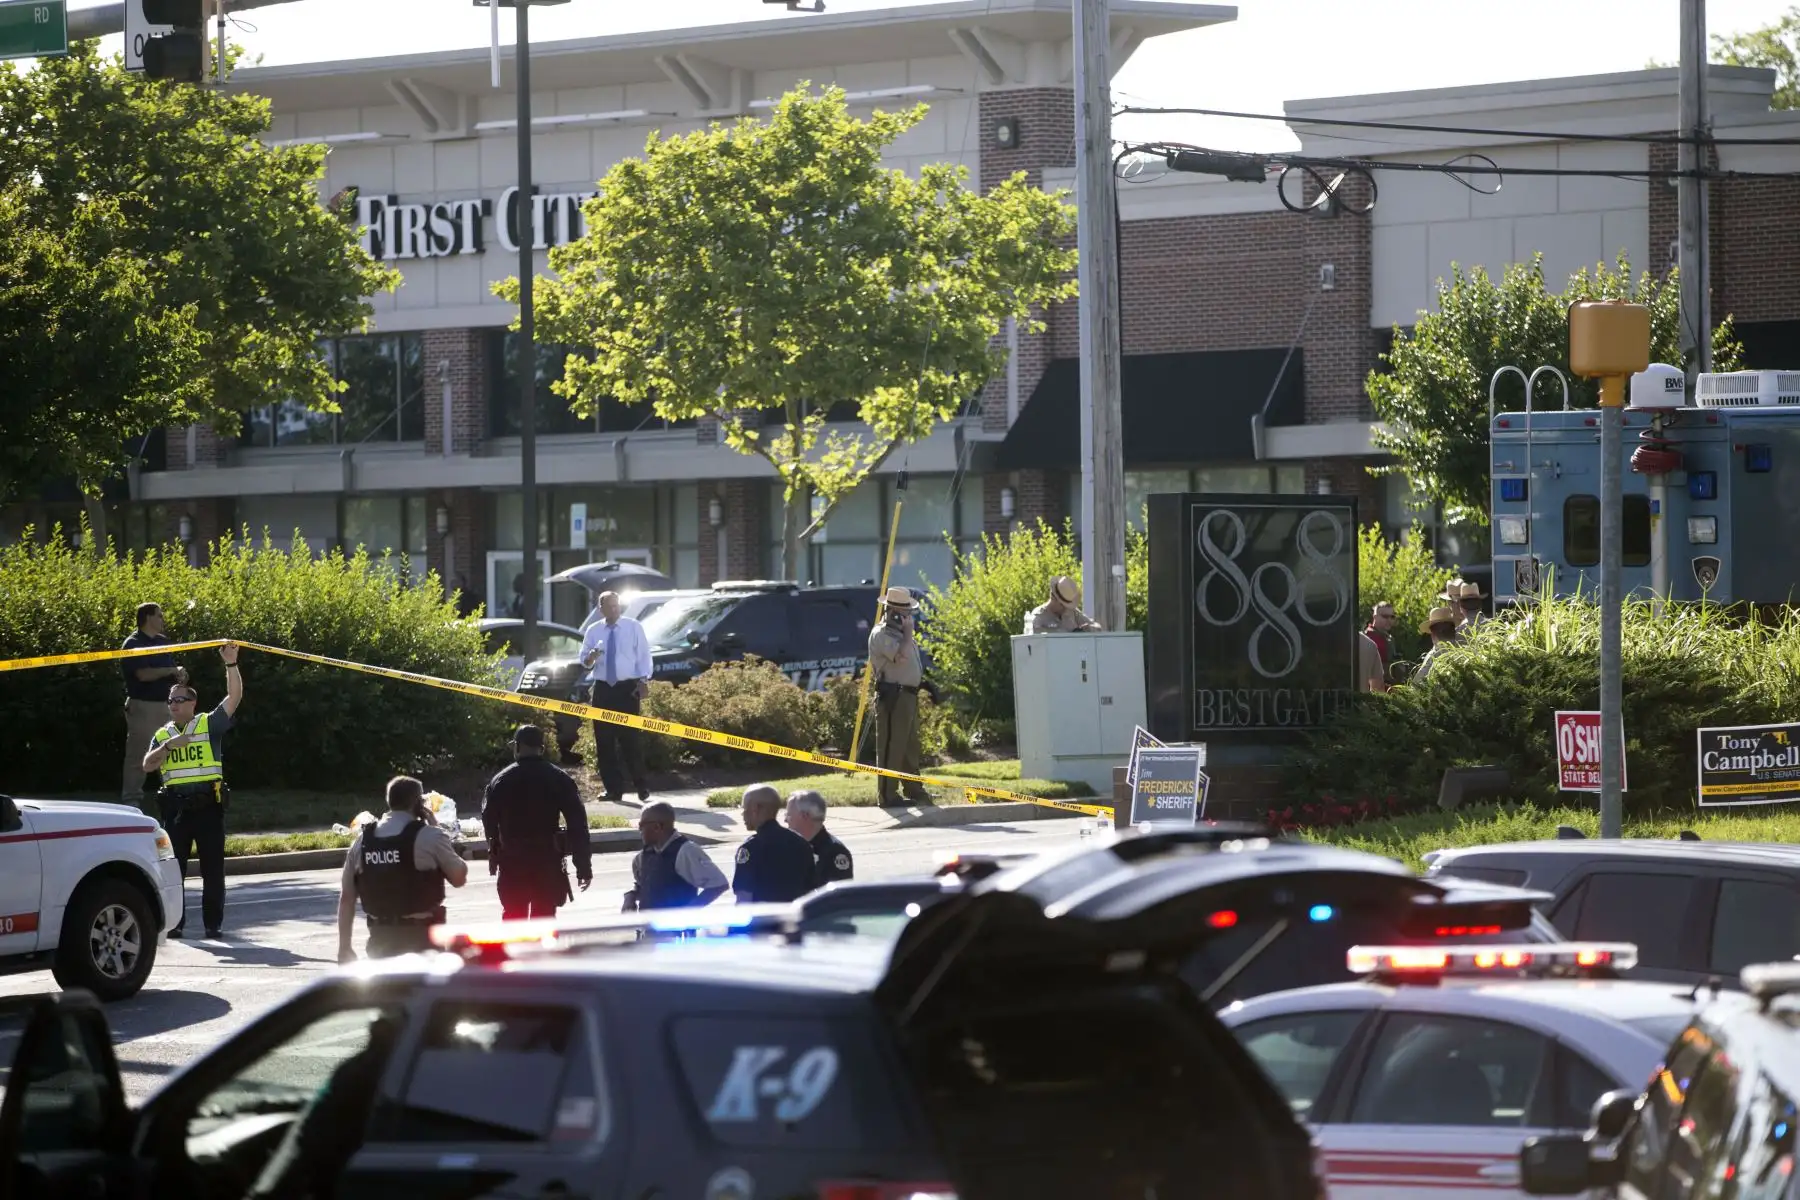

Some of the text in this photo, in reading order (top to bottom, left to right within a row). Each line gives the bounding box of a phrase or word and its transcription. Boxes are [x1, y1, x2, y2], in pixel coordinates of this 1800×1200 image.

[34, 7, 49, 24] RD
[357, 194, 484, 260] FIRST
[1664, 377, 1684, 389] BMS
[1197, 509, 1349, 679] 888
[820, 656, 857, 669] COUNTY
[519, 695, 548, 707] CAUTION
[560, 703, 588, 715] CAUTION
[601, 711, 629, 724] CAUTION
[642, 719, 671, 733] CAUTION
[684, 727, 712, 741] CAUTION
[726, 735, 755, 749] CAUTION
[1560, 723, 1602, 763] O'SH
[1717, 735, 1761, 753] Tony
[768, 745, 797, 758] CAUTION
[811, 754, 840, 766] CAUTION
[1703, 746, 1800, 776] Campbell
[1563, 771, 1602, 784] STATE DEL
[1773, 769, 1800, 779] SENATE
[1138, 781, 1195, 794] FREDERICKS
[1156, 796, 1194, 809] SHERIFF
[365, 850, 401, 865] POLICE
[703, 1046, 841, 1123] K-9
